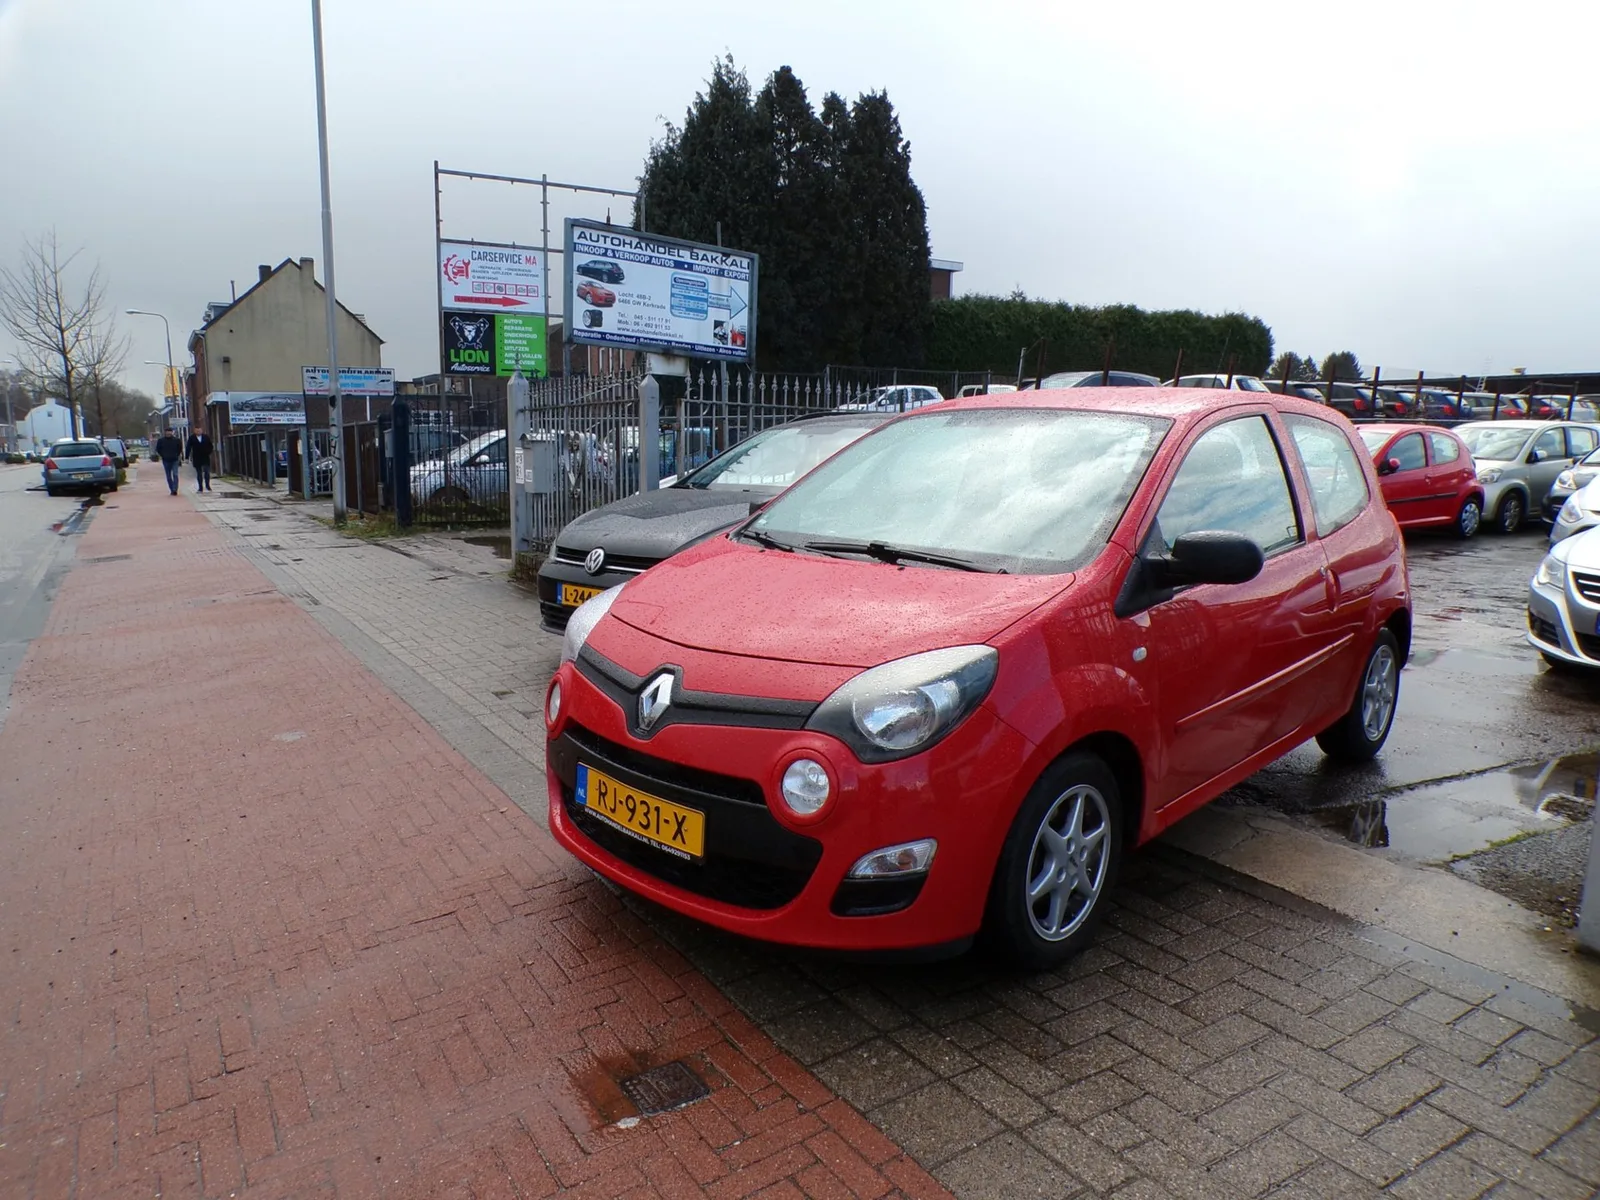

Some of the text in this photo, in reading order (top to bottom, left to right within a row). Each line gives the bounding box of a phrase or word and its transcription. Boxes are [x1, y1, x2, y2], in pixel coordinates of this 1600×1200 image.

[471, 250, 537, 266] CARSERVICE MA
[577, 231, 750, 270] AUTOHANDEL BAKKALI
[575, 243, 750, 281] INKOOP & VERKOOP AUTOS IMPORT EXPORT
[573, 329, 601, 339] Reparatie
[605, 333, 636, 343] Onderhoud
[450, 349, 490, 363] LION
[450, 362, 490, 372] Autoservice
[564, 587, 600, 603] L-244
[577, 787, 586, 799] NL
[597, 778, 687, 845] RJ-931-X
